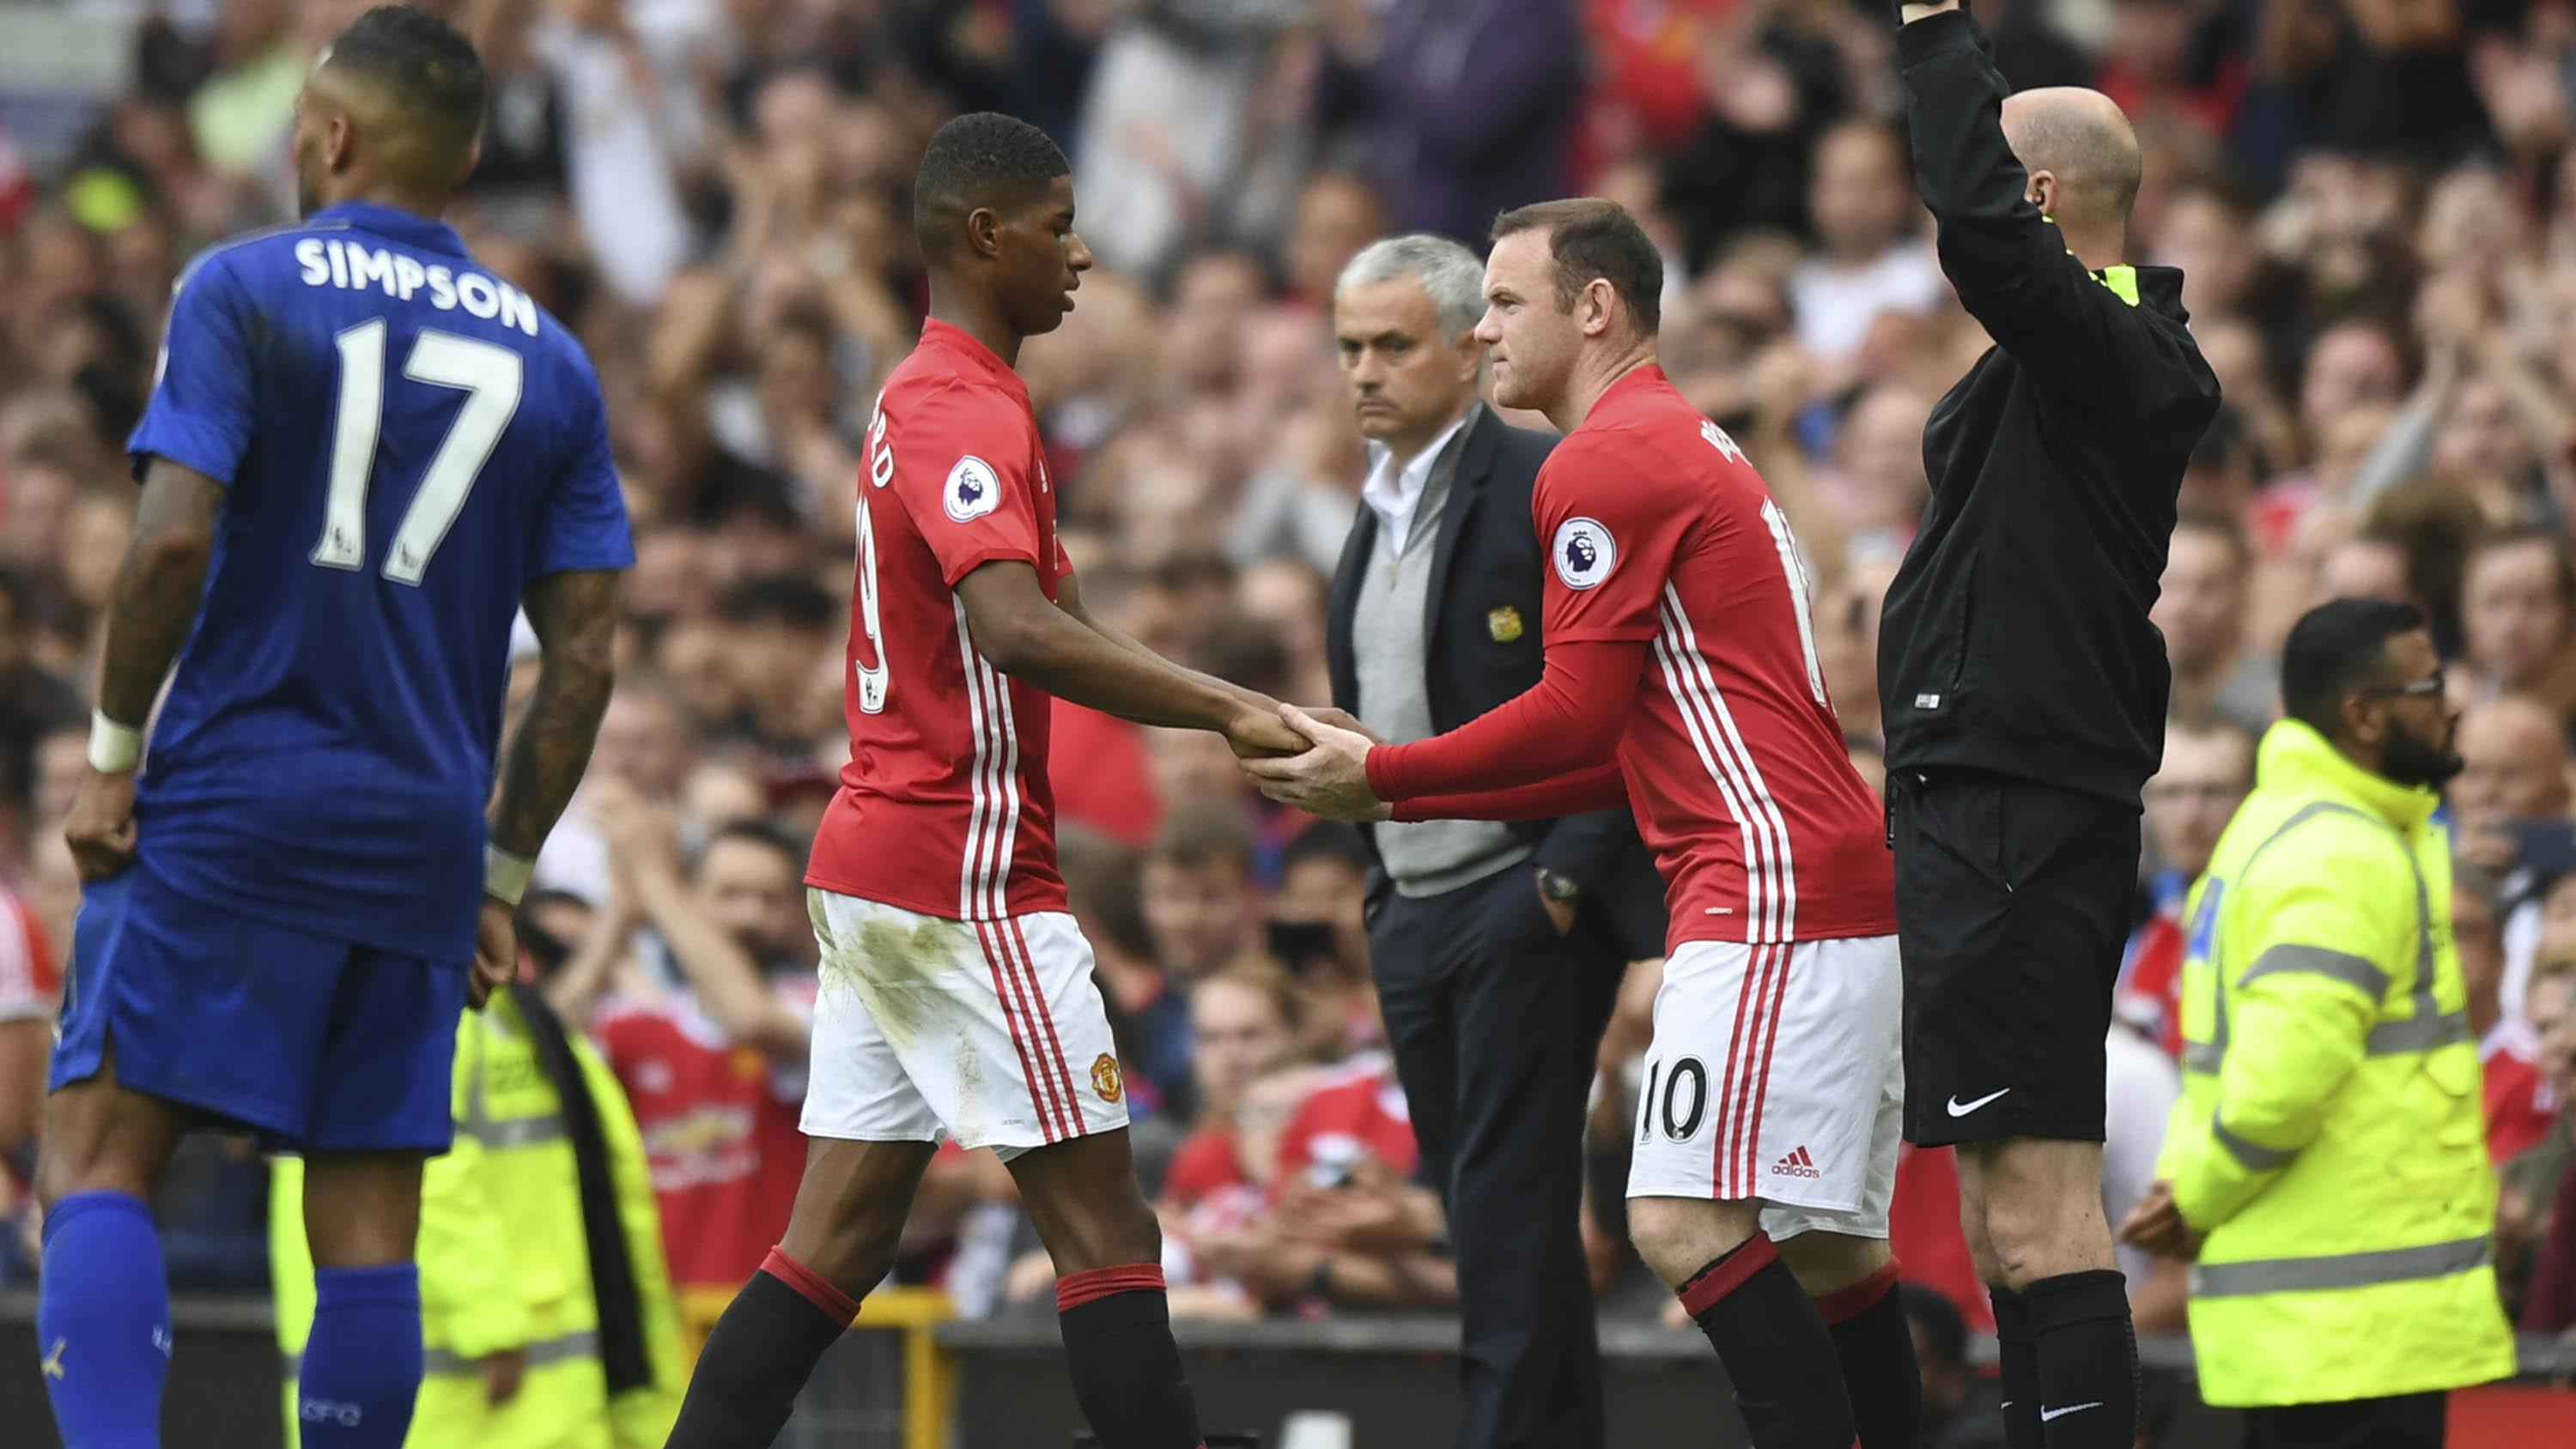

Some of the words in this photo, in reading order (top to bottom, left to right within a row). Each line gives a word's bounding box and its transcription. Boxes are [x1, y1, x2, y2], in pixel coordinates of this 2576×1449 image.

[295, 238, 538, 336] SIMPSON
[310, 316, 523, 587] 17
[867, 388, 894, 488] RD
[854, 493, 890, 714] 9
[1759, 495, 1838, 718] 1
[1640, 1056, 1708, 1144] 10
[1771, 1164, 1820, 1179] adidas
